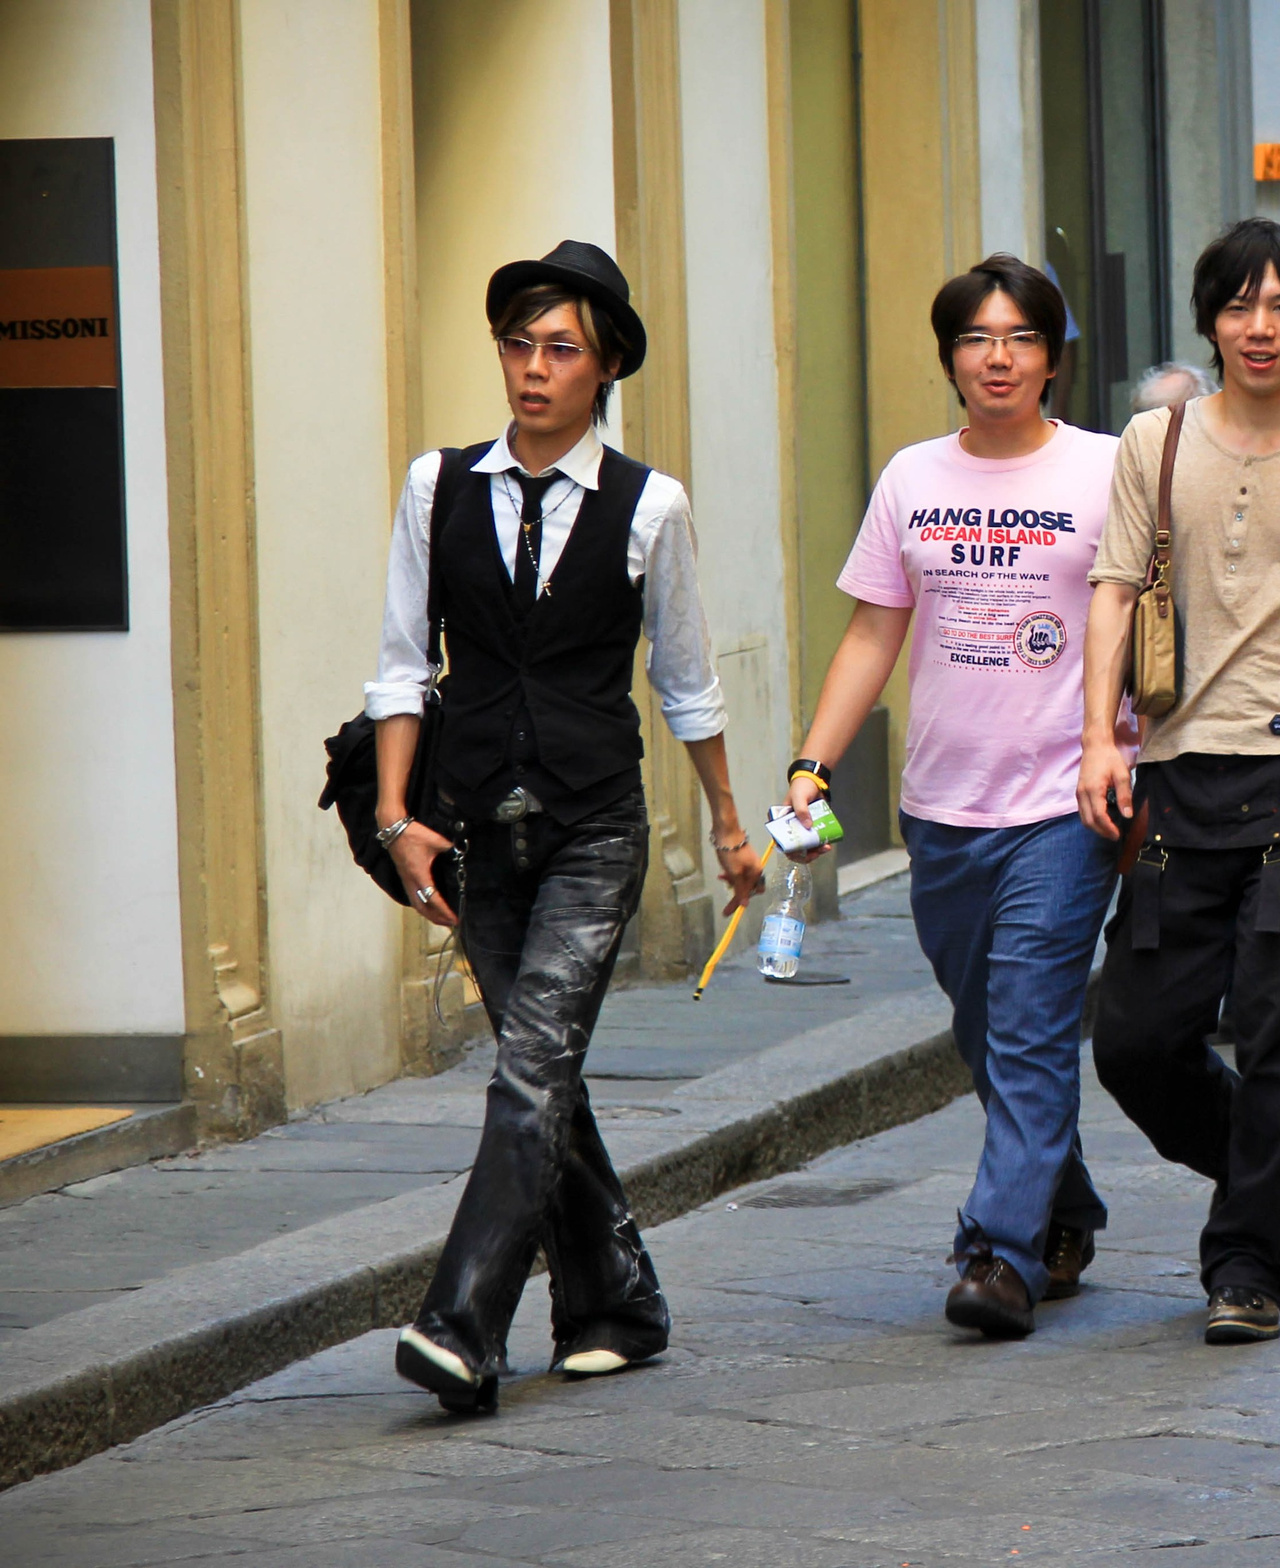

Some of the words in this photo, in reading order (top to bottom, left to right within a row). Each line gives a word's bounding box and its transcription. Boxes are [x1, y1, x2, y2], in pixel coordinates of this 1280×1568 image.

[0, 317, 109, 340] MISSONI
[908, 508, 982, 529] HANG
[987, 508, 1076, 533] LOOSE
[920, 526, 982, 542] OCEAN
[987, 528, 1056, 546] ISLAND
[951, 543, 1021, 567] SURF
[923, 569, 933, 577] IN
[935, 569, 978, 579] SEARCH
[997, 572, 1017, 580] THE
[1019, 573, 1050, 581] WAVE
[943, 628, 951, 636] GO
[958, 630, 966, 638] DO
[950, 653, 1010, 666] EXCELLENCE
